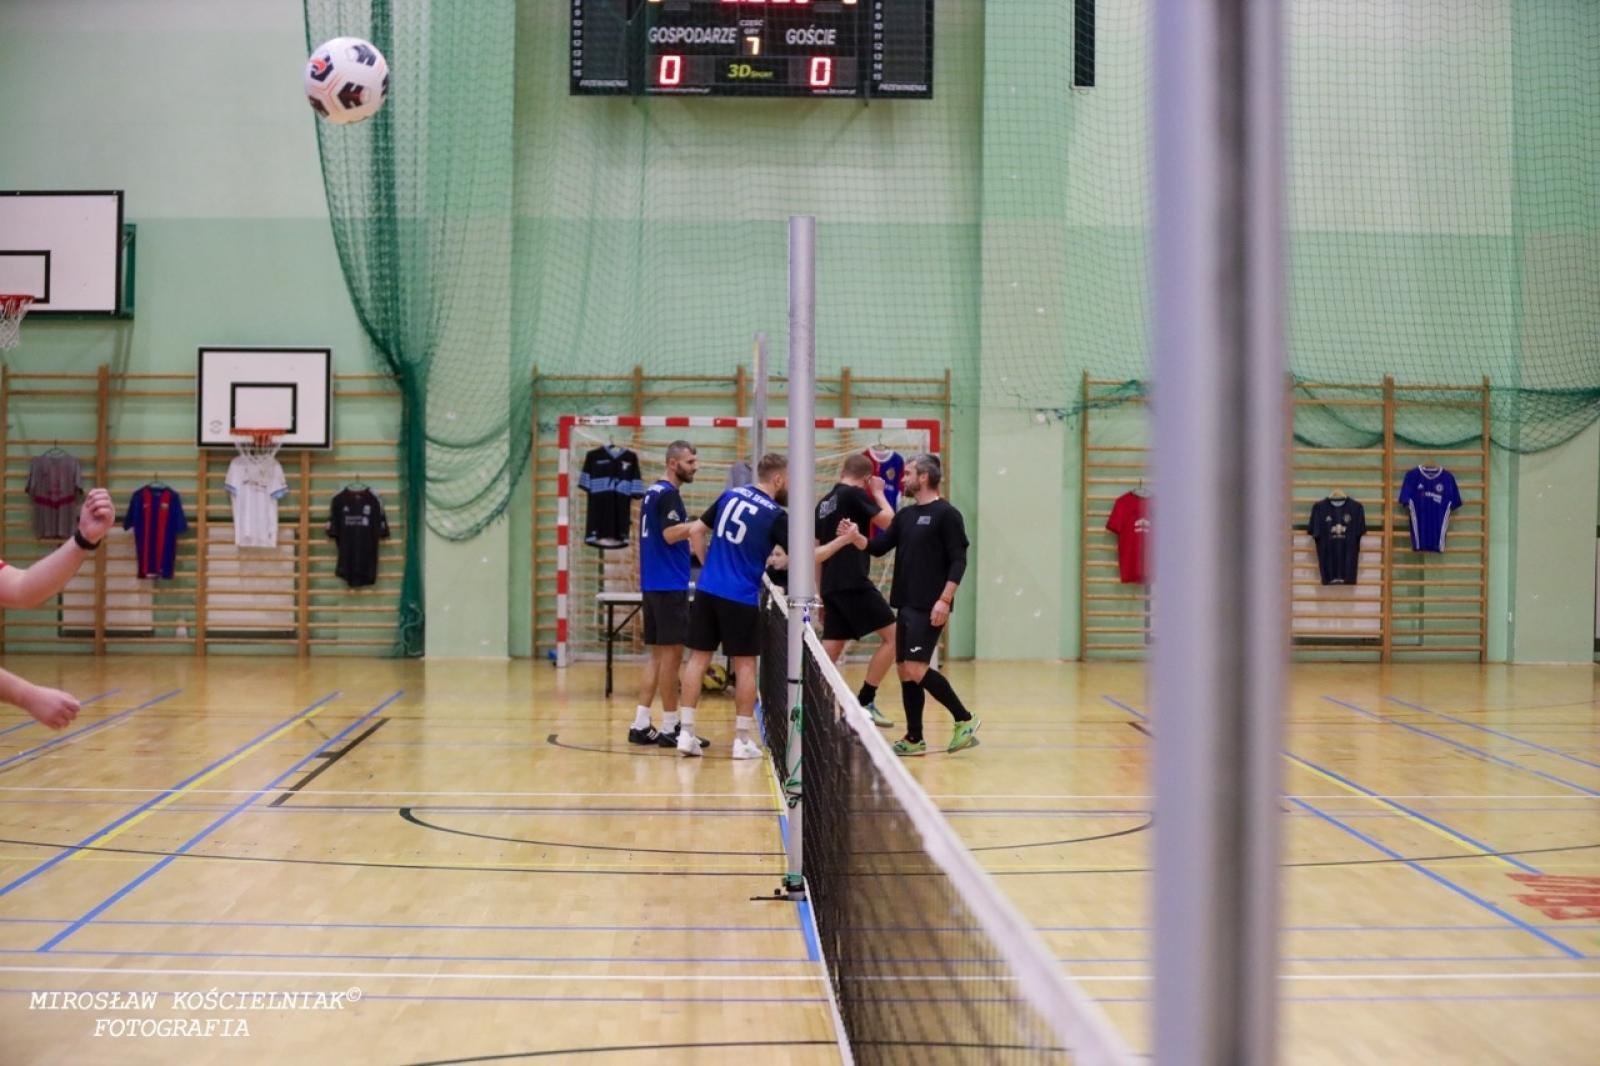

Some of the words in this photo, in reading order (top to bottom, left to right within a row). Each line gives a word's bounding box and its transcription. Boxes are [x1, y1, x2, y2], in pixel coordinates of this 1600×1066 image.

[648, 26, 738, 44] GOSPODARZE
[785, 24, 837, 45] GOŚCIE
[659, 55, 681, 85] 0
[809, 56, 831, 86] 0
[717, 497, 759, 544] 15
